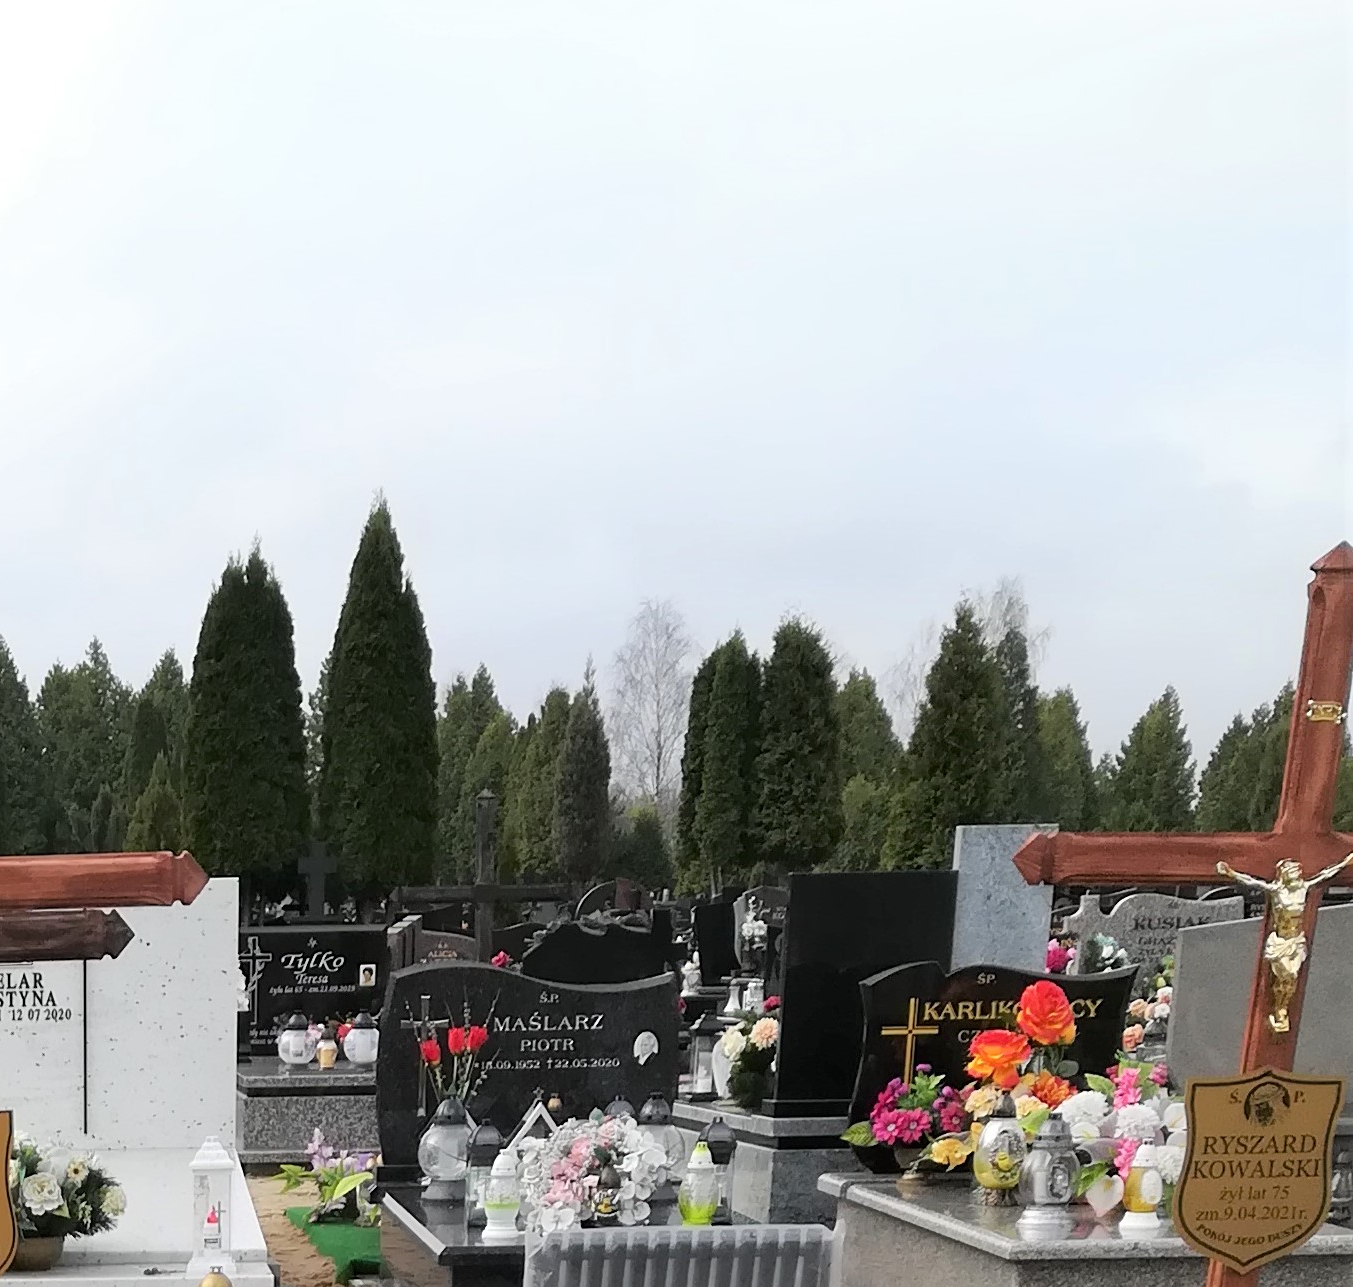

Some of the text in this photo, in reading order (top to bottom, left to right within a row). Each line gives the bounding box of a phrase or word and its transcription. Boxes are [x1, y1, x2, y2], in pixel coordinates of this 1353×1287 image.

[281, 951, 345, 975] Tylko
[296, 972, 329, 985] Teresa
[28, 1008, 41, 1021] 07
[44, 1008, 73, 1021] 2020
[493, 1011, 604, 1032] MAŚLARZ
[520, 1038, 575, 1052] PIOTR
[1202, 1134, 1317, 1155] RYSZARD
[1191, 1159, 1321, 1180] KOWALSKI
[1219, 1185, 1291, 1204] żył lat 75
[1234, 1236, 1265, 1246] JEGO
